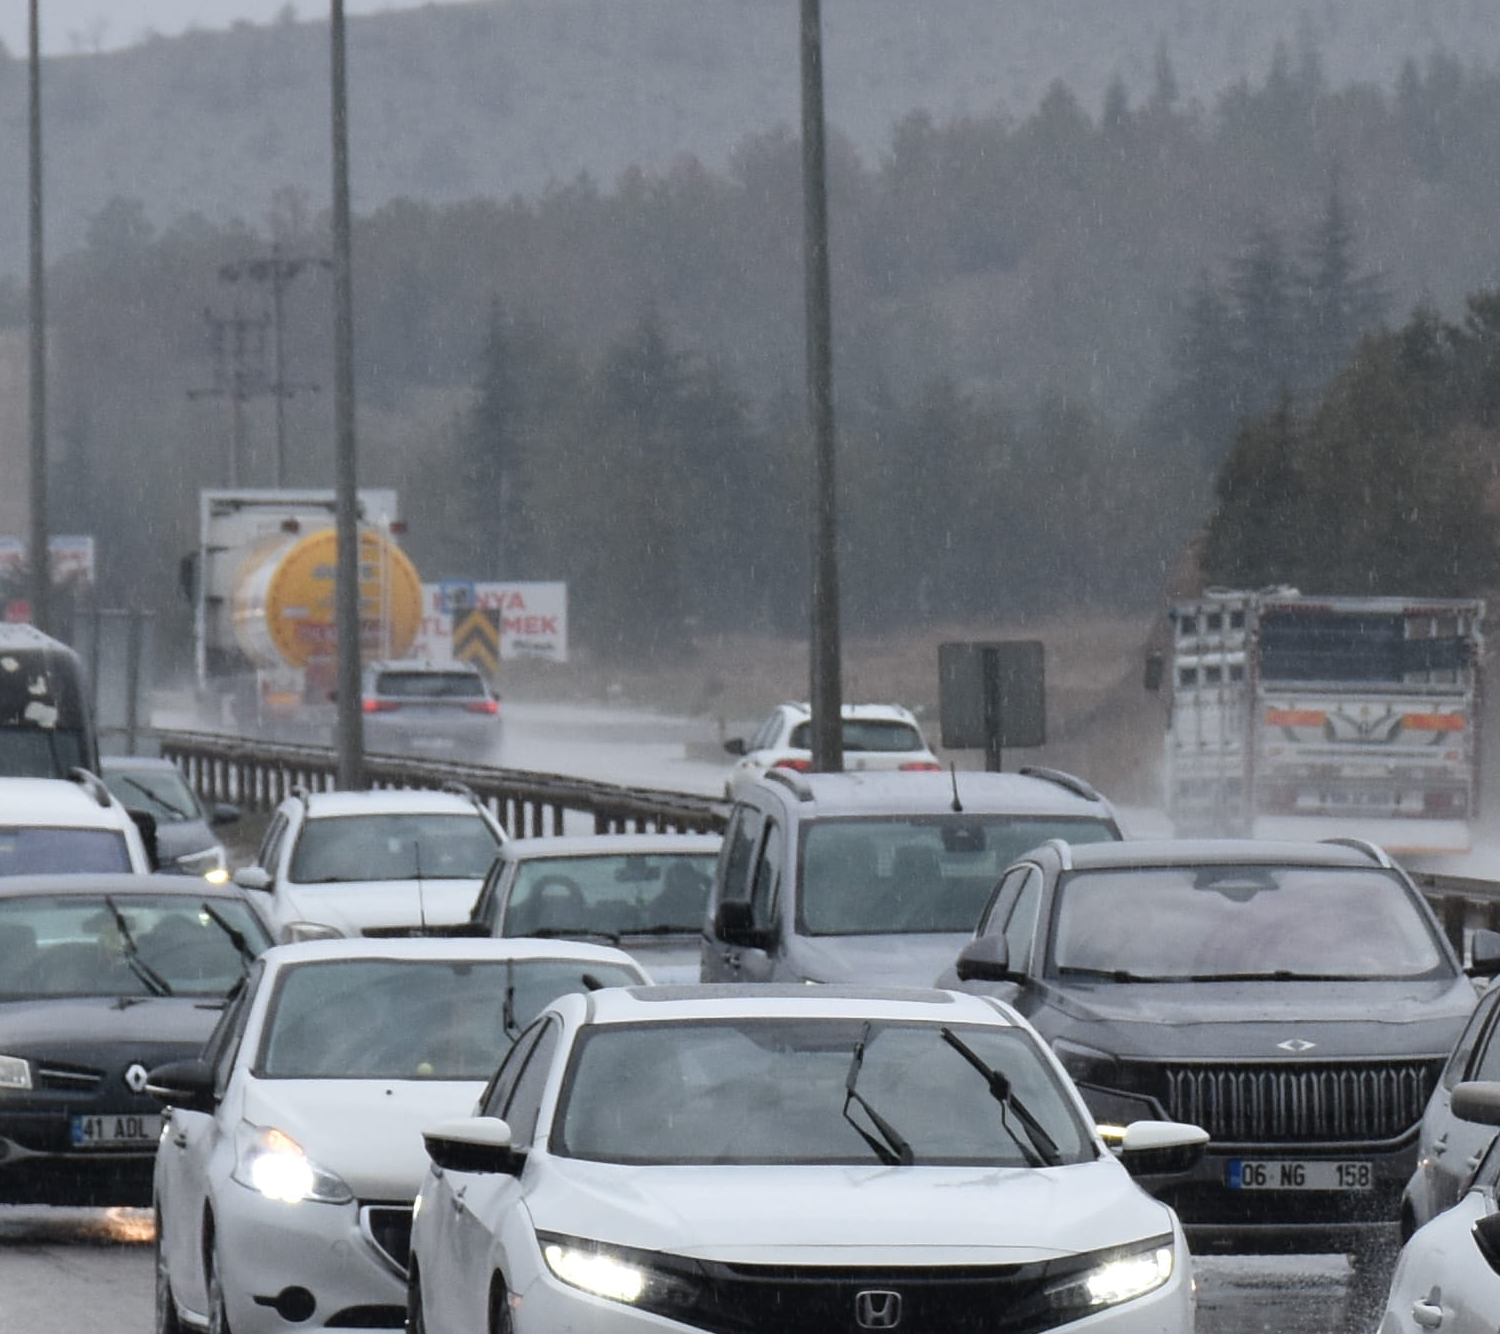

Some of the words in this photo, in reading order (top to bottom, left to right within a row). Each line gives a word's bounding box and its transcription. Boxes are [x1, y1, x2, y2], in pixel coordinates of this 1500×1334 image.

[83, 1117, 103, 1138] 41
[114, 1117, 149, 1138] ADL
[1242, 1164, 1266, 1186] 06
[1280, 1164, 1305, 1186] NG
[1336, 1164, 1369, 1186] 158
